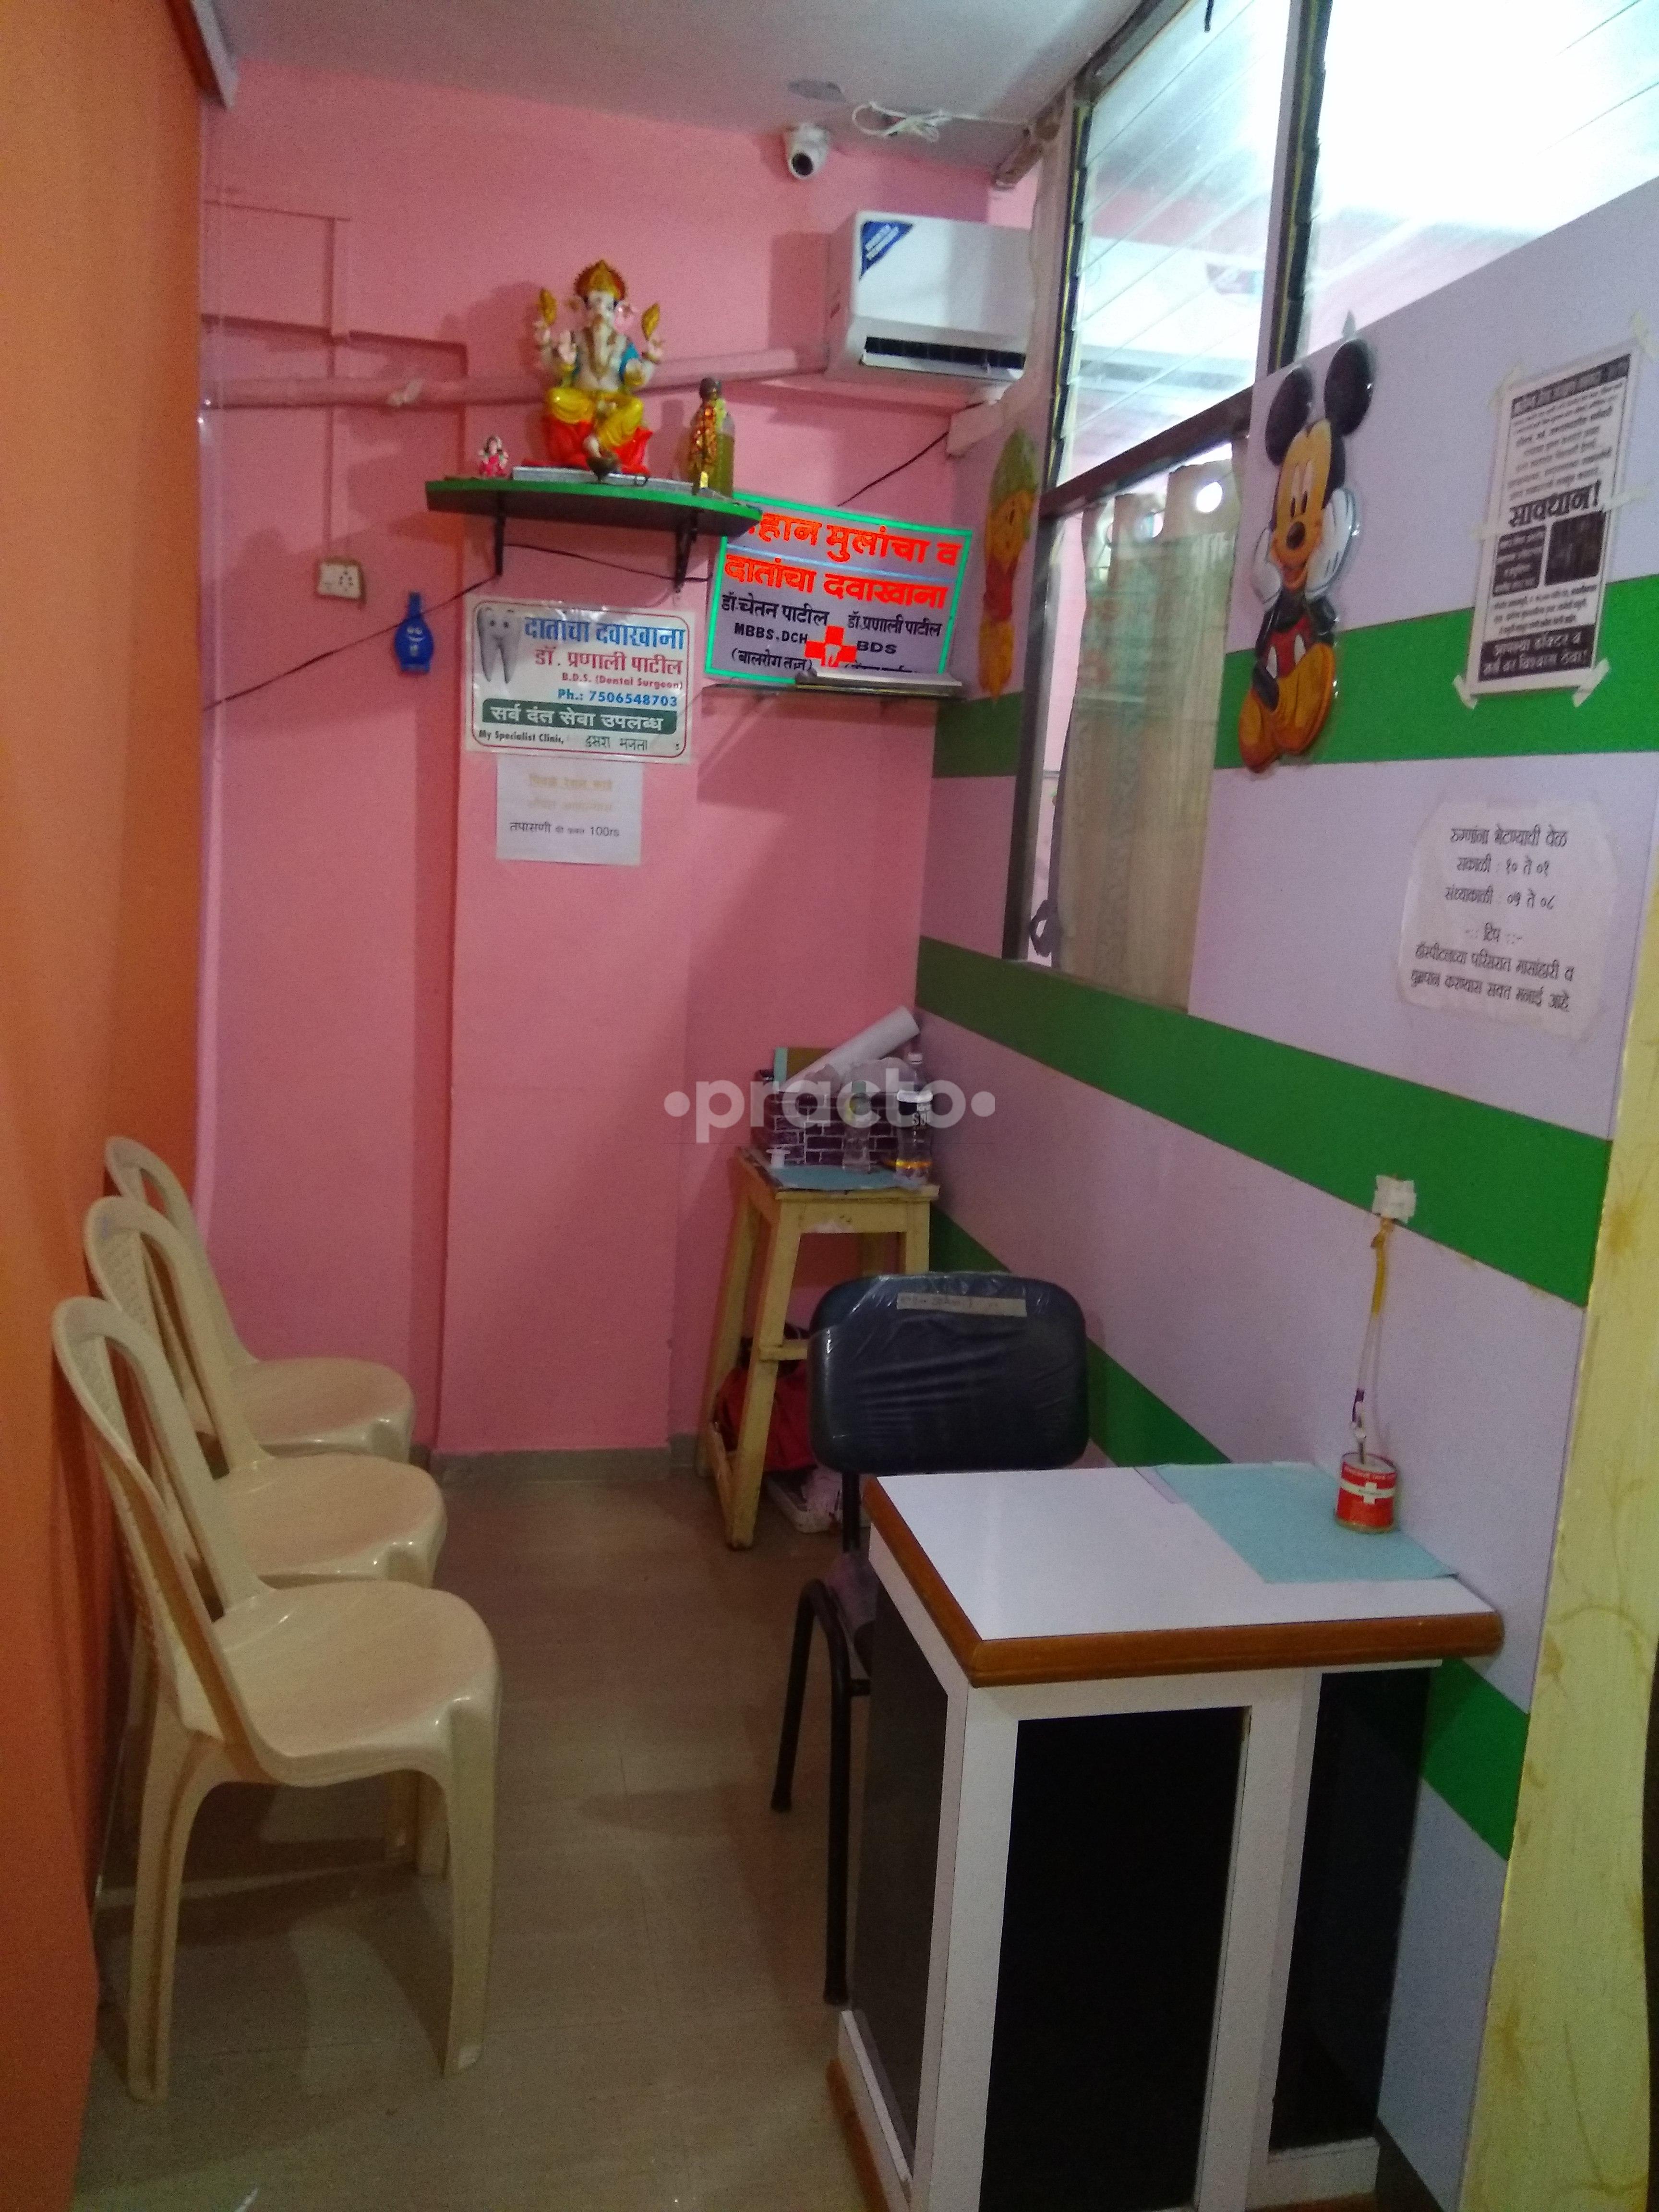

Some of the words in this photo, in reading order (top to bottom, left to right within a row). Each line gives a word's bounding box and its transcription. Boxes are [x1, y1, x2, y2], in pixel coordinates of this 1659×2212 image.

[748, 512, 822, 546] हान
[826, 524, 931, 565] मुलांचा
[937, 540, 963, 567] व
[724, 553, 817, 593] दातांचा
[824, 573, 949, 609] दवाखाना
[782, 602, 830, 626] पाटील
[596, 623, 685, 649] दवाखाना
[905, 617, 942, 637] पाटील
[857, 640, 898, 654] BDS
[568, 651, 626, 671] प्रणाली
[632, 654, 683, 675] पाटील
[562, 672, 591, 682] B.D.S.
[589, 690, 677, 707] 7506548703
[490, 706, 522, 722] सर्व
[526, 706, 554, 724] दंत
[559, 707, 596, 727] सेवा
[600, 713, 664, 731] उपलब्ध
[495, 731, 536, 743] Specialist
